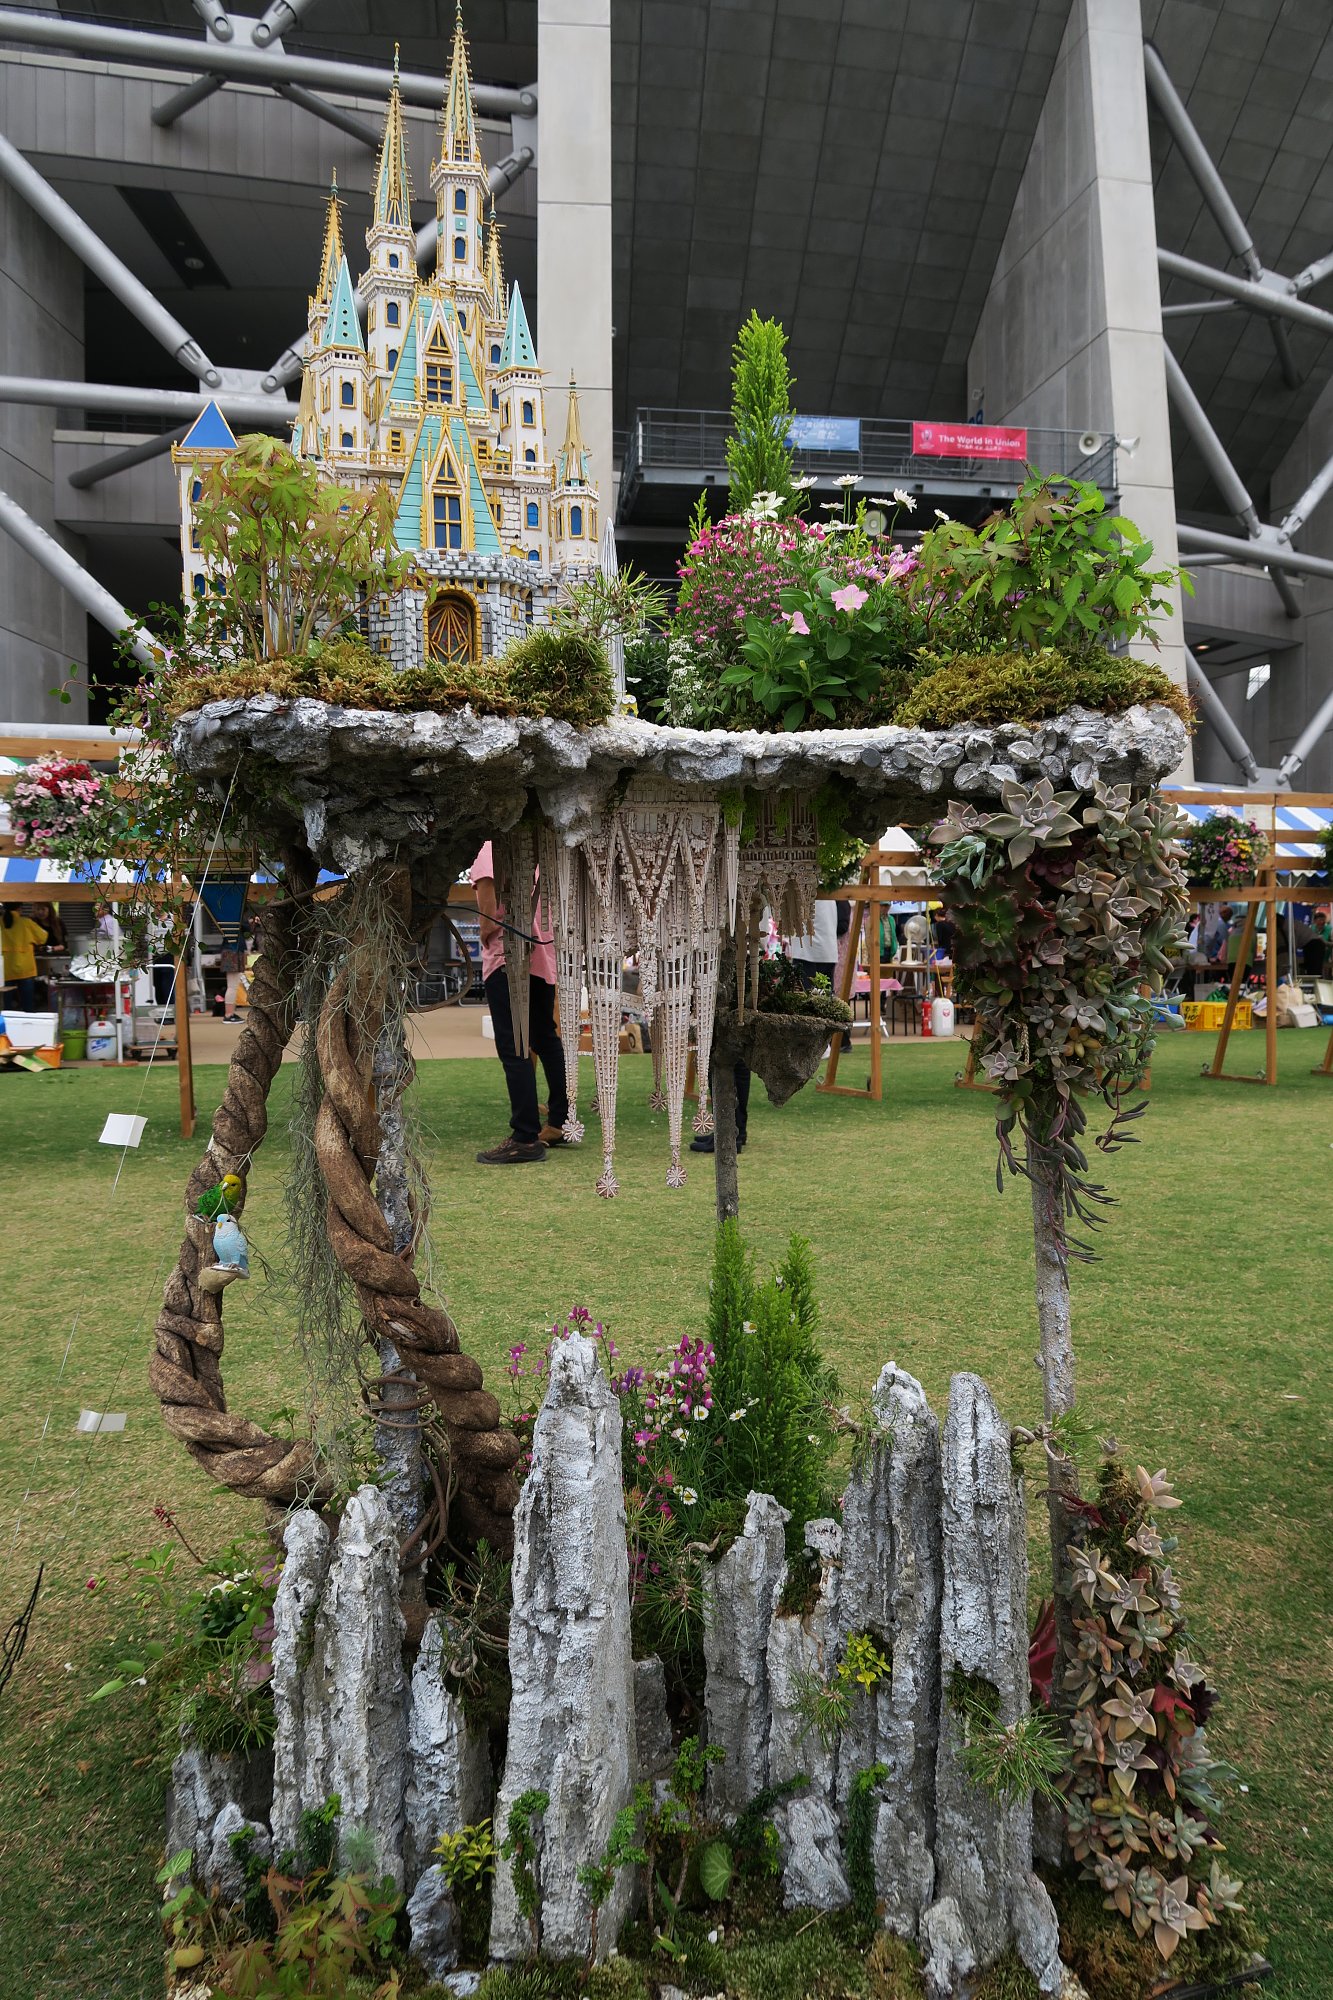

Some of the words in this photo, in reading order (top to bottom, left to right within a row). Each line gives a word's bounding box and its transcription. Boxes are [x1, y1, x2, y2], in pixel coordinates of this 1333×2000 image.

[788, 429, 841, 440] 生に一度だ。
[939, 434, 955, 443] The
[957, 436, 982, 445] World
[995, 439, 1020, 447] Union
